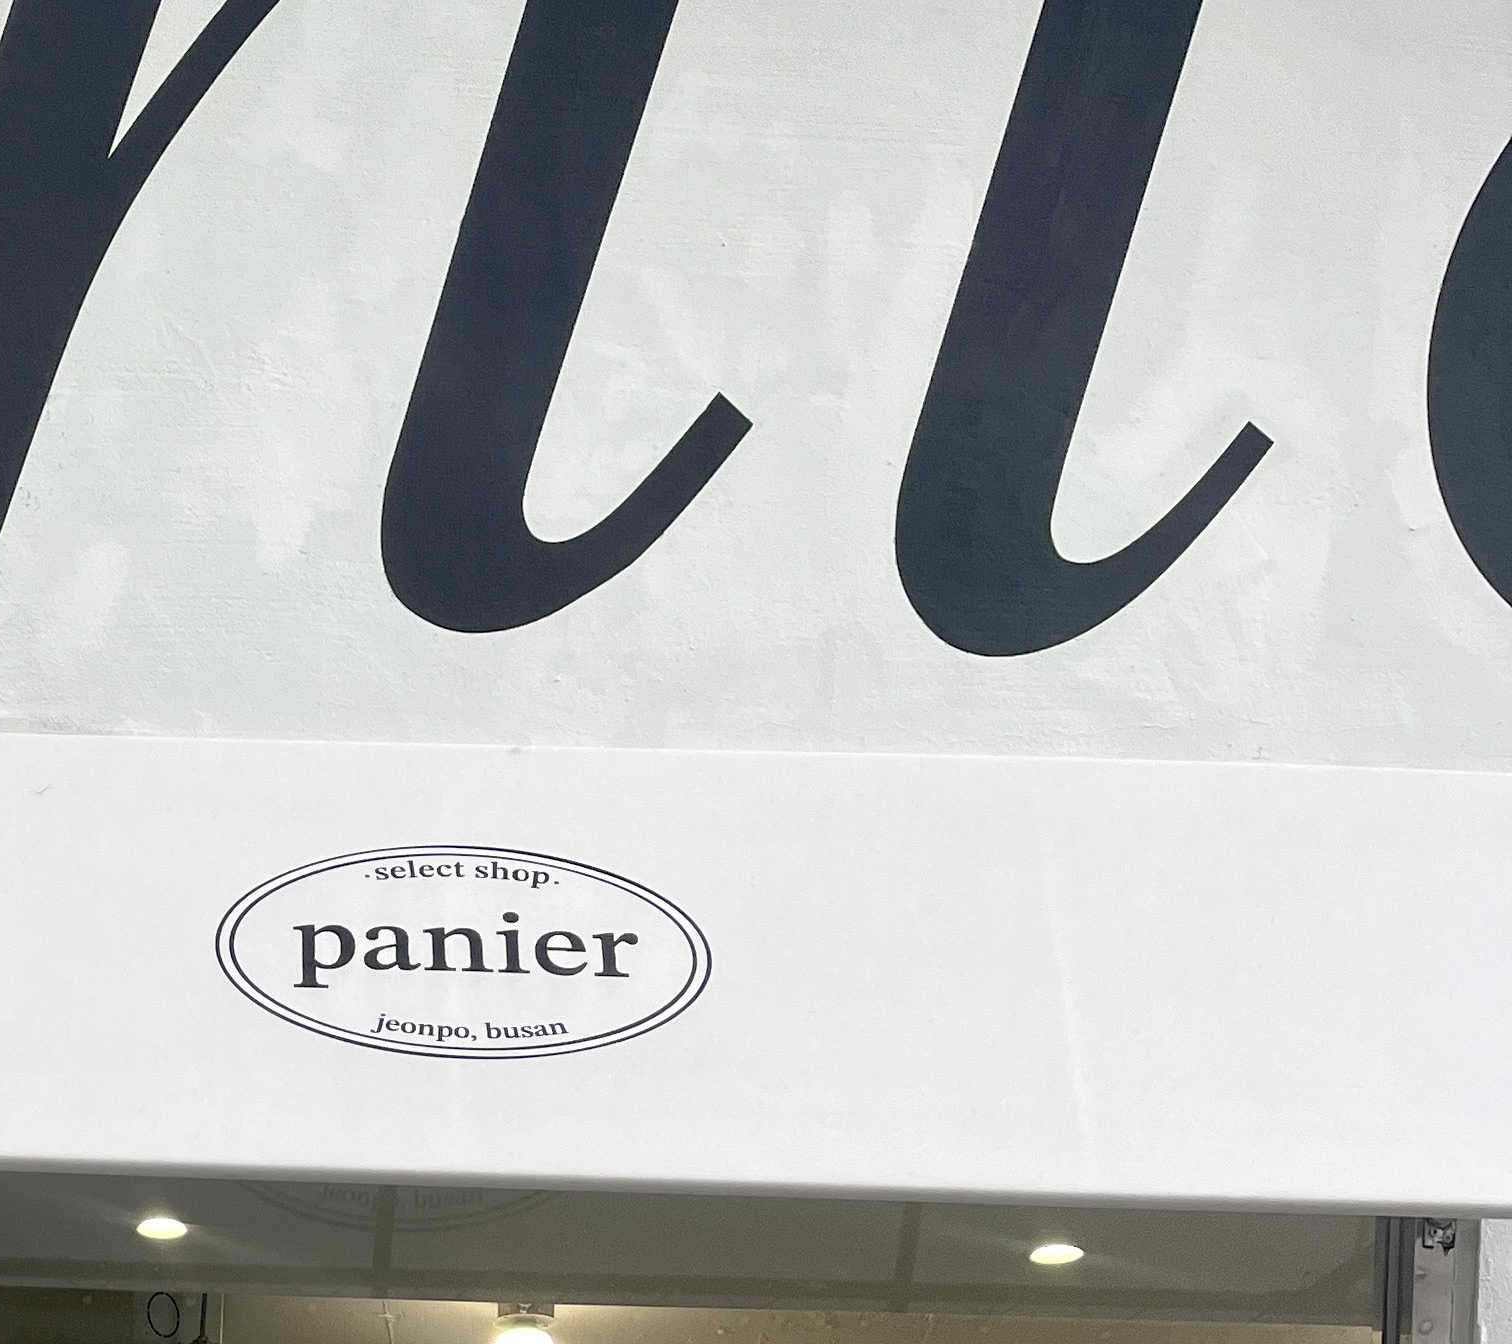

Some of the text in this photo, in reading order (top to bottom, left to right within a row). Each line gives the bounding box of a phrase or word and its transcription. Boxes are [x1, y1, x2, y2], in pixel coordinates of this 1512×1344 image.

[292, 911, 639, 989] panier
[370, 1013, 569, 1042] jeonpo, busan
